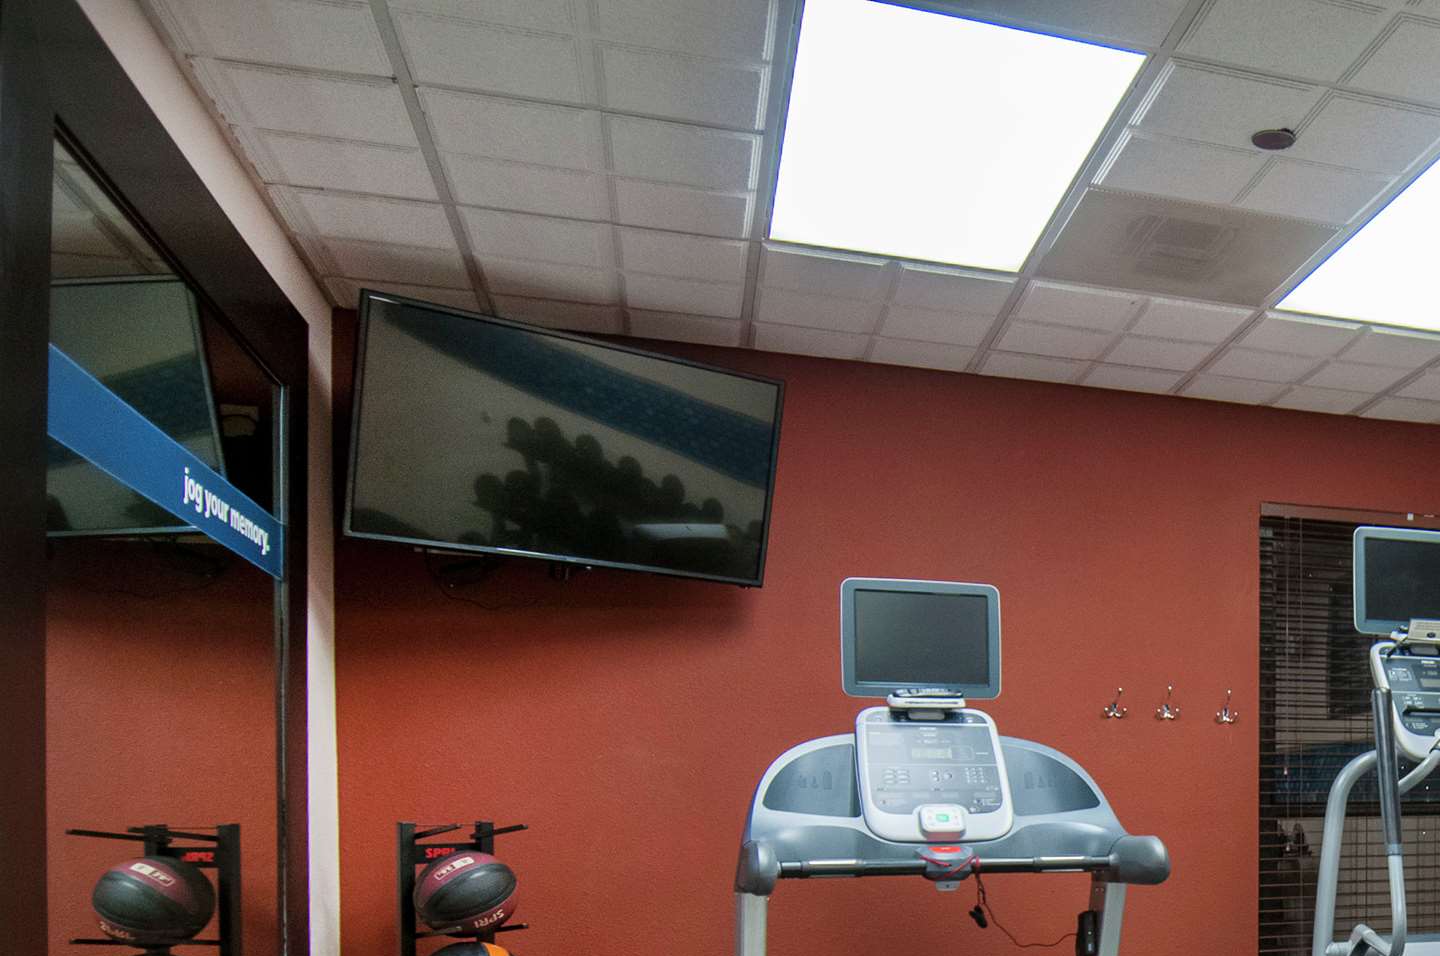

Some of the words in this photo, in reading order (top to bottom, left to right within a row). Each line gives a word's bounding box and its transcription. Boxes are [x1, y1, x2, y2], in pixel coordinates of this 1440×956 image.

[183, 466, 204, 513] jog
[204, 488, 230, 519] your
[230, 507, 270, 556] memory.
[473, 908, 505, 929] SPRI
